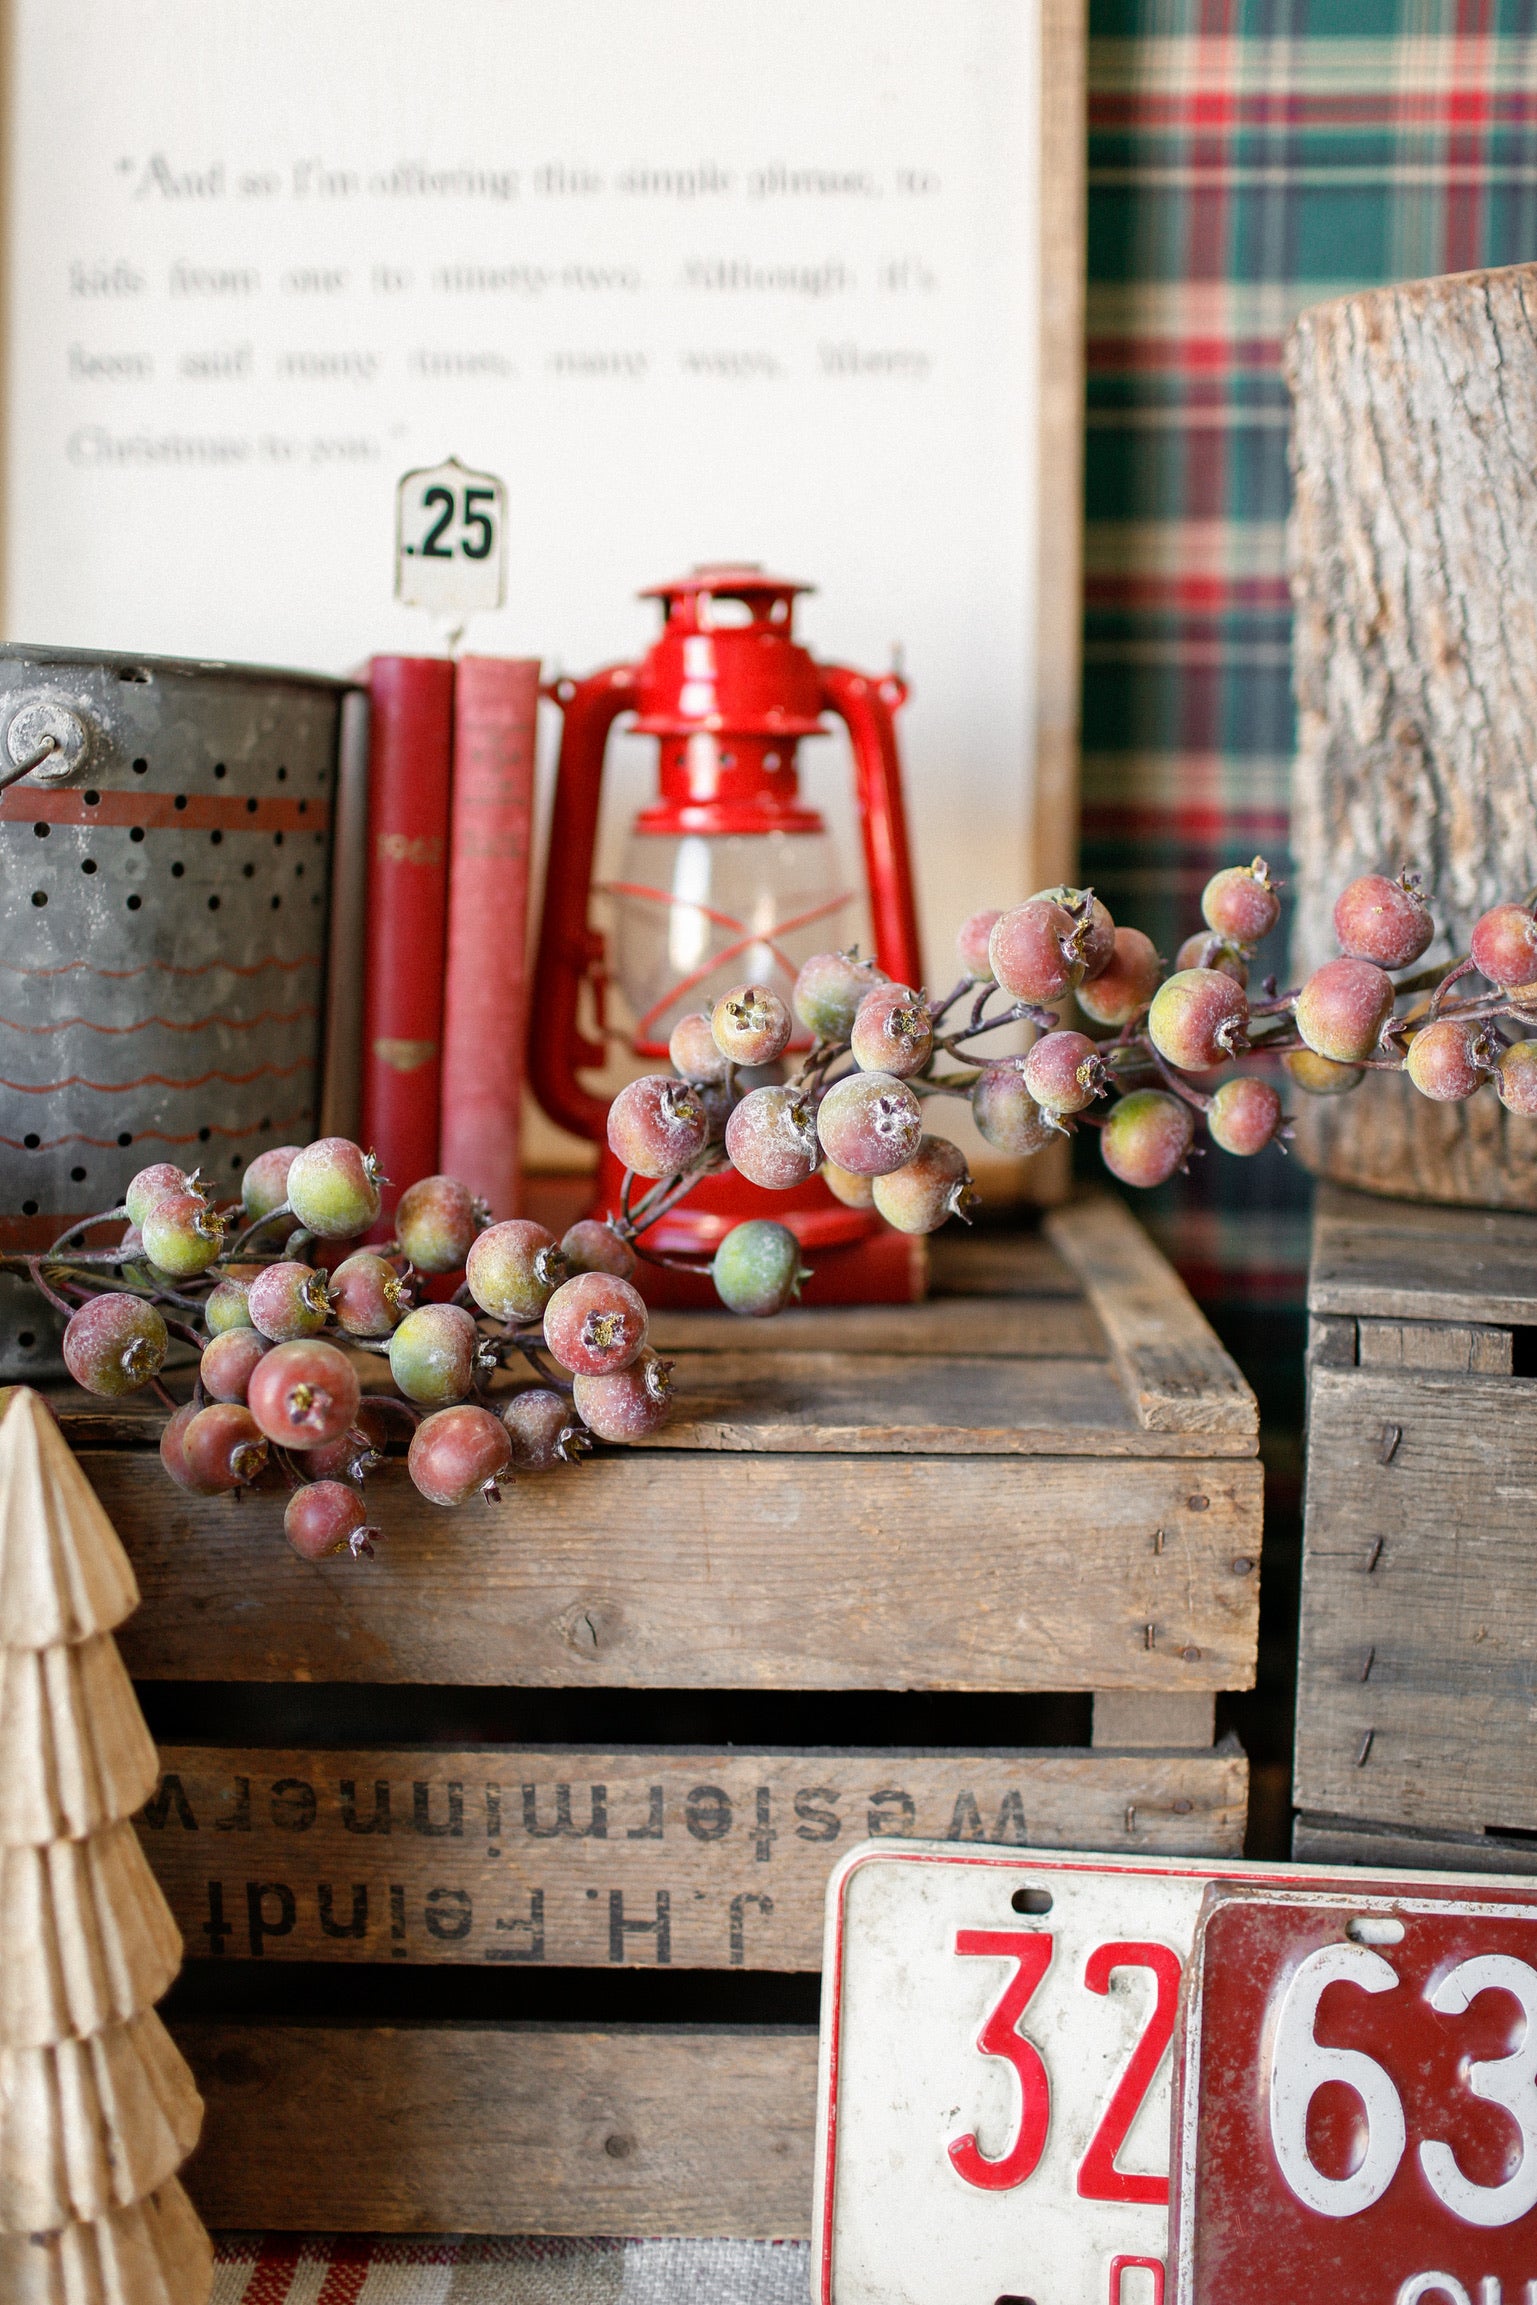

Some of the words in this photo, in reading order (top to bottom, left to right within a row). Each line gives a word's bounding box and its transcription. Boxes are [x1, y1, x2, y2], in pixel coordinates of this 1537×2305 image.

[369, 157, 521, 204] offering
[616, 160, 734, 203] simple
[895, 165, 940, 198] to
[168, 258, 261, 298] from
[281, 265, 350, 297] one
[370, 262, 411, 295] to
[683, 254, 857, 301] Although
[878, 256, 938, 294] it's
[67, 342, 154, 381] been
[178, 340, 255, 381] said
[276, 348, 380, 385] many
[546, 349, 649, 383] many
[65, 425, 250, 468] Christmas
[406, 486, 494, 559] .25
[201, 1880, 545, 1962] Feindt
[947, 1928, 1184, 2204] 32
[1270, 1942, 1537, 2227] 63
